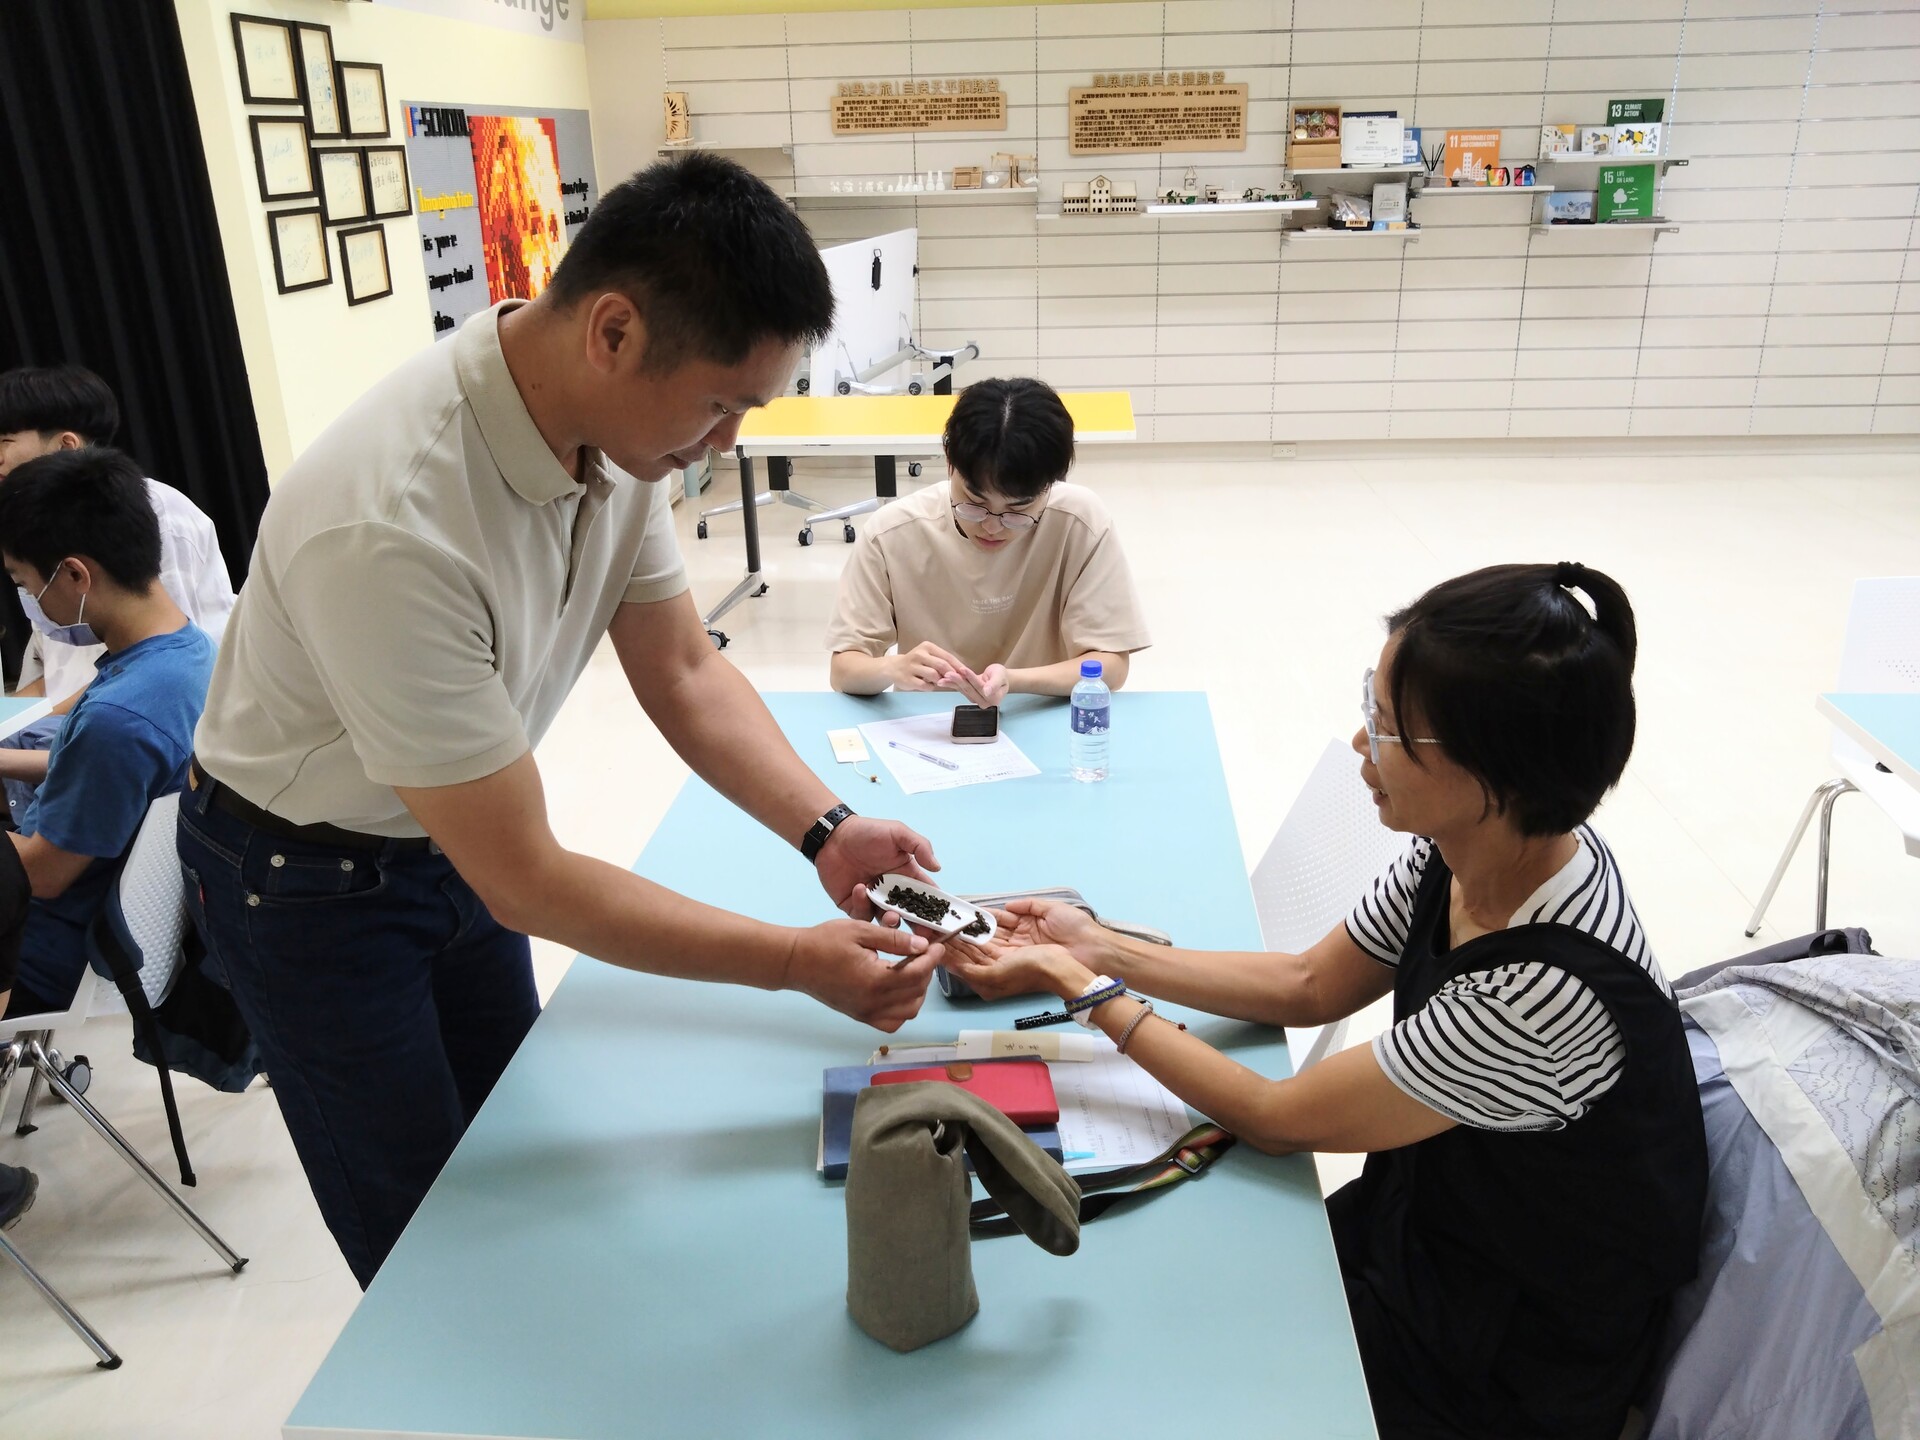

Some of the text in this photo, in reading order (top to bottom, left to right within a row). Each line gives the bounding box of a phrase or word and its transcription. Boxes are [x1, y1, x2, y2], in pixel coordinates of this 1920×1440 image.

[1611, 103, 1622, 117] 13
[1449, 134, 1459, 148] 11
[1603, 170, 1614, 184] 15
